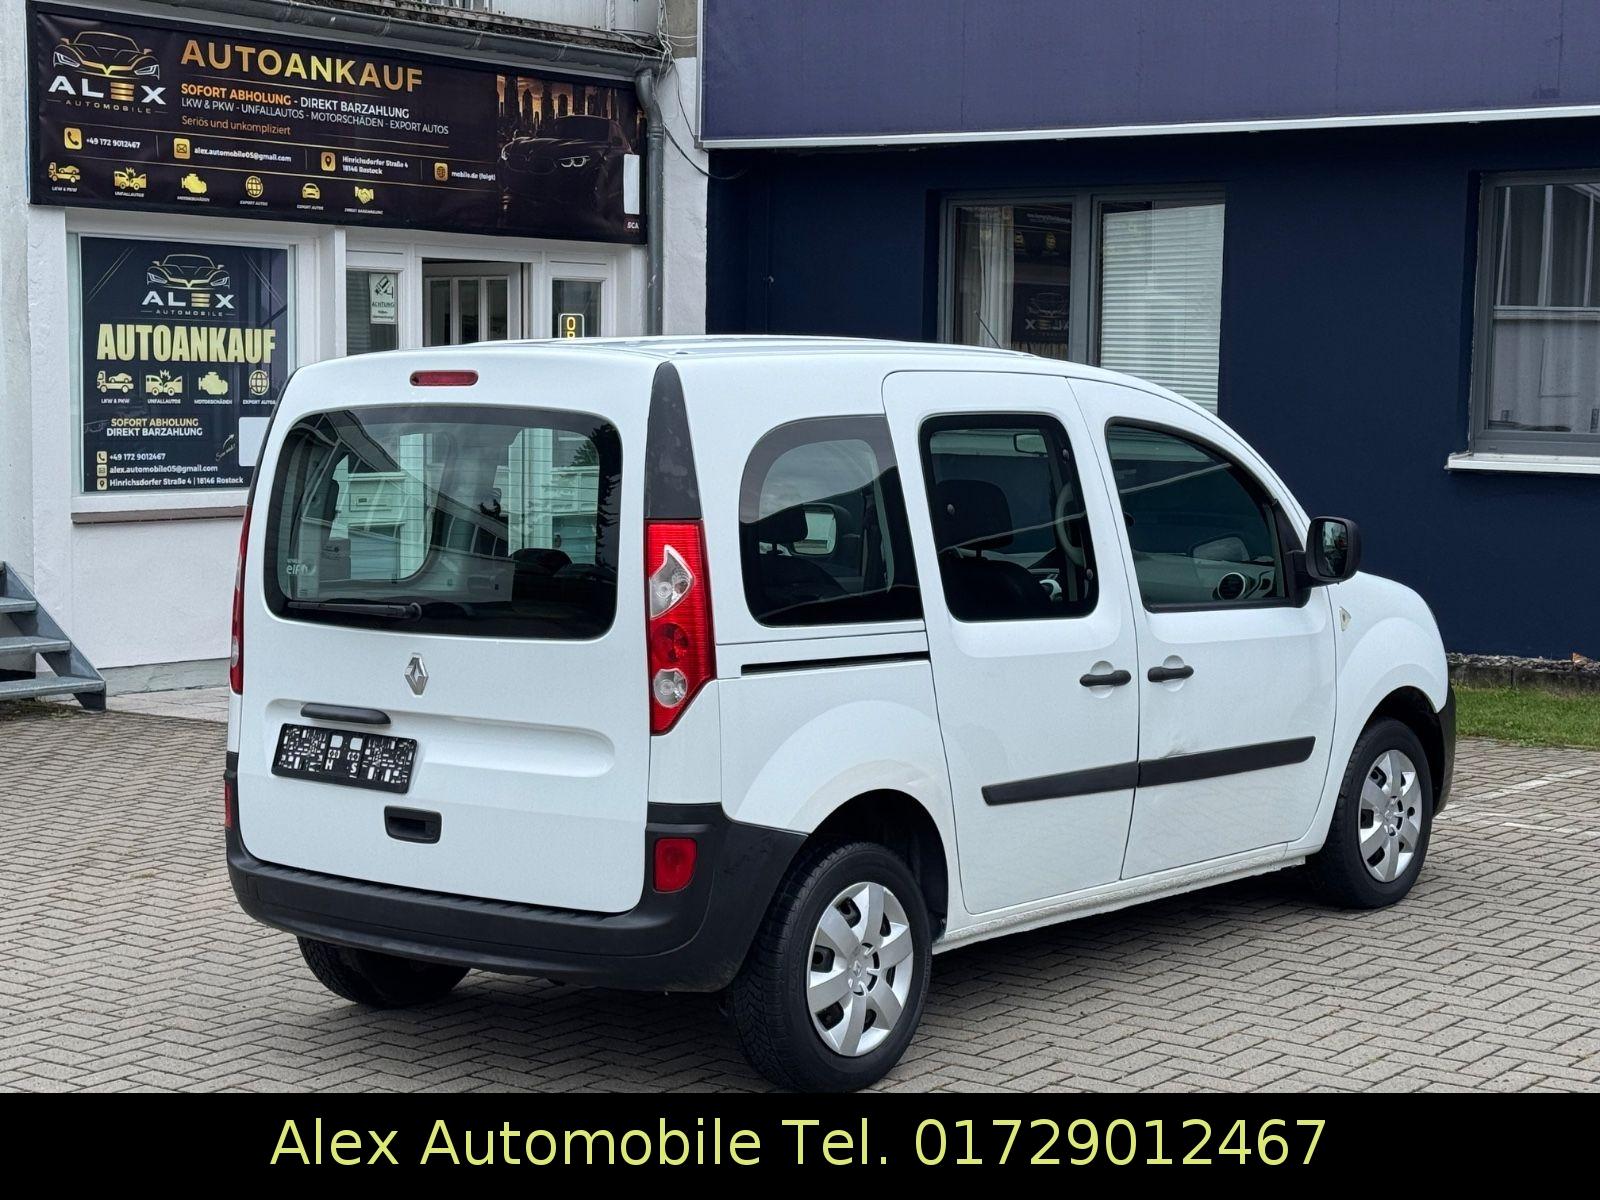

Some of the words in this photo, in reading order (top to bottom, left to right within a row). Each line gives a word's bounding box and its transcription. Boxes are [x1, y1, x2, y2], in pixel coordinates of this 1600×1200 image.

[181, 39, 423, 93] AUTOANKAUF
[48, 75, 167, 106] ALEX
[65, 99, 152, 115] AUTOMOBILE
[181, 83, 227, 99] SOFORT
[229, 89, 292, 106] ABHOLUNG
[300, 96, 338, 111] DIREKT
[340, 101, 410, 119] BARZAHLUNG
[181, 97, 202, 109] LKW
[203, 99, 211, 110] &
[212, 100, 234, 112] PKW
[241, 103, 304, 119] UNFALLAUTOS
[310, 111, 384, 128] MOTORSCHÄDEN
[389, 119, 421, 132] EXPORT
[421, 124, 449, 135] AUTOS
[181, 115, 209, 128] Seriös
[210, 119, 229, 130] und
[230, 121, 291, 136] unkompliziert
[86, 137, 99, 145] +49
[100, 138, 112, 147] 172
[112, 139, 141, 150] 9012467
[194, 146, 292, 162] alex.automobile05@gmail.com
[342, 155, 386, 167] Hinrichsdorfer
[358, 167, 383, 175] Rostock
[141, 290, 235, 310] ALEX
[155, 308, 223, 318] AUTOMOBILE
[96, 323, 276, 364] AUTOANKAUF
[110, 418, 148, 427] SOFORT
[149, 418, 199, 428] ABHOLUNG
[106, 427, 141, 437] DIREKT
[141, 427, 203, 438] BARZAHLUNG
[109, 453, 122, 461] +49
[123, 453, 136, 461] 172
[136, 452, 166, 461] 9012467
[109, 464, 218, 474] alex.automobile05@gmail.com
[109, 478, 162, 487] Hinrichsdorfer
[162, 477, 186, 486] Straße
[215, 476, 244, 485] Rostock
